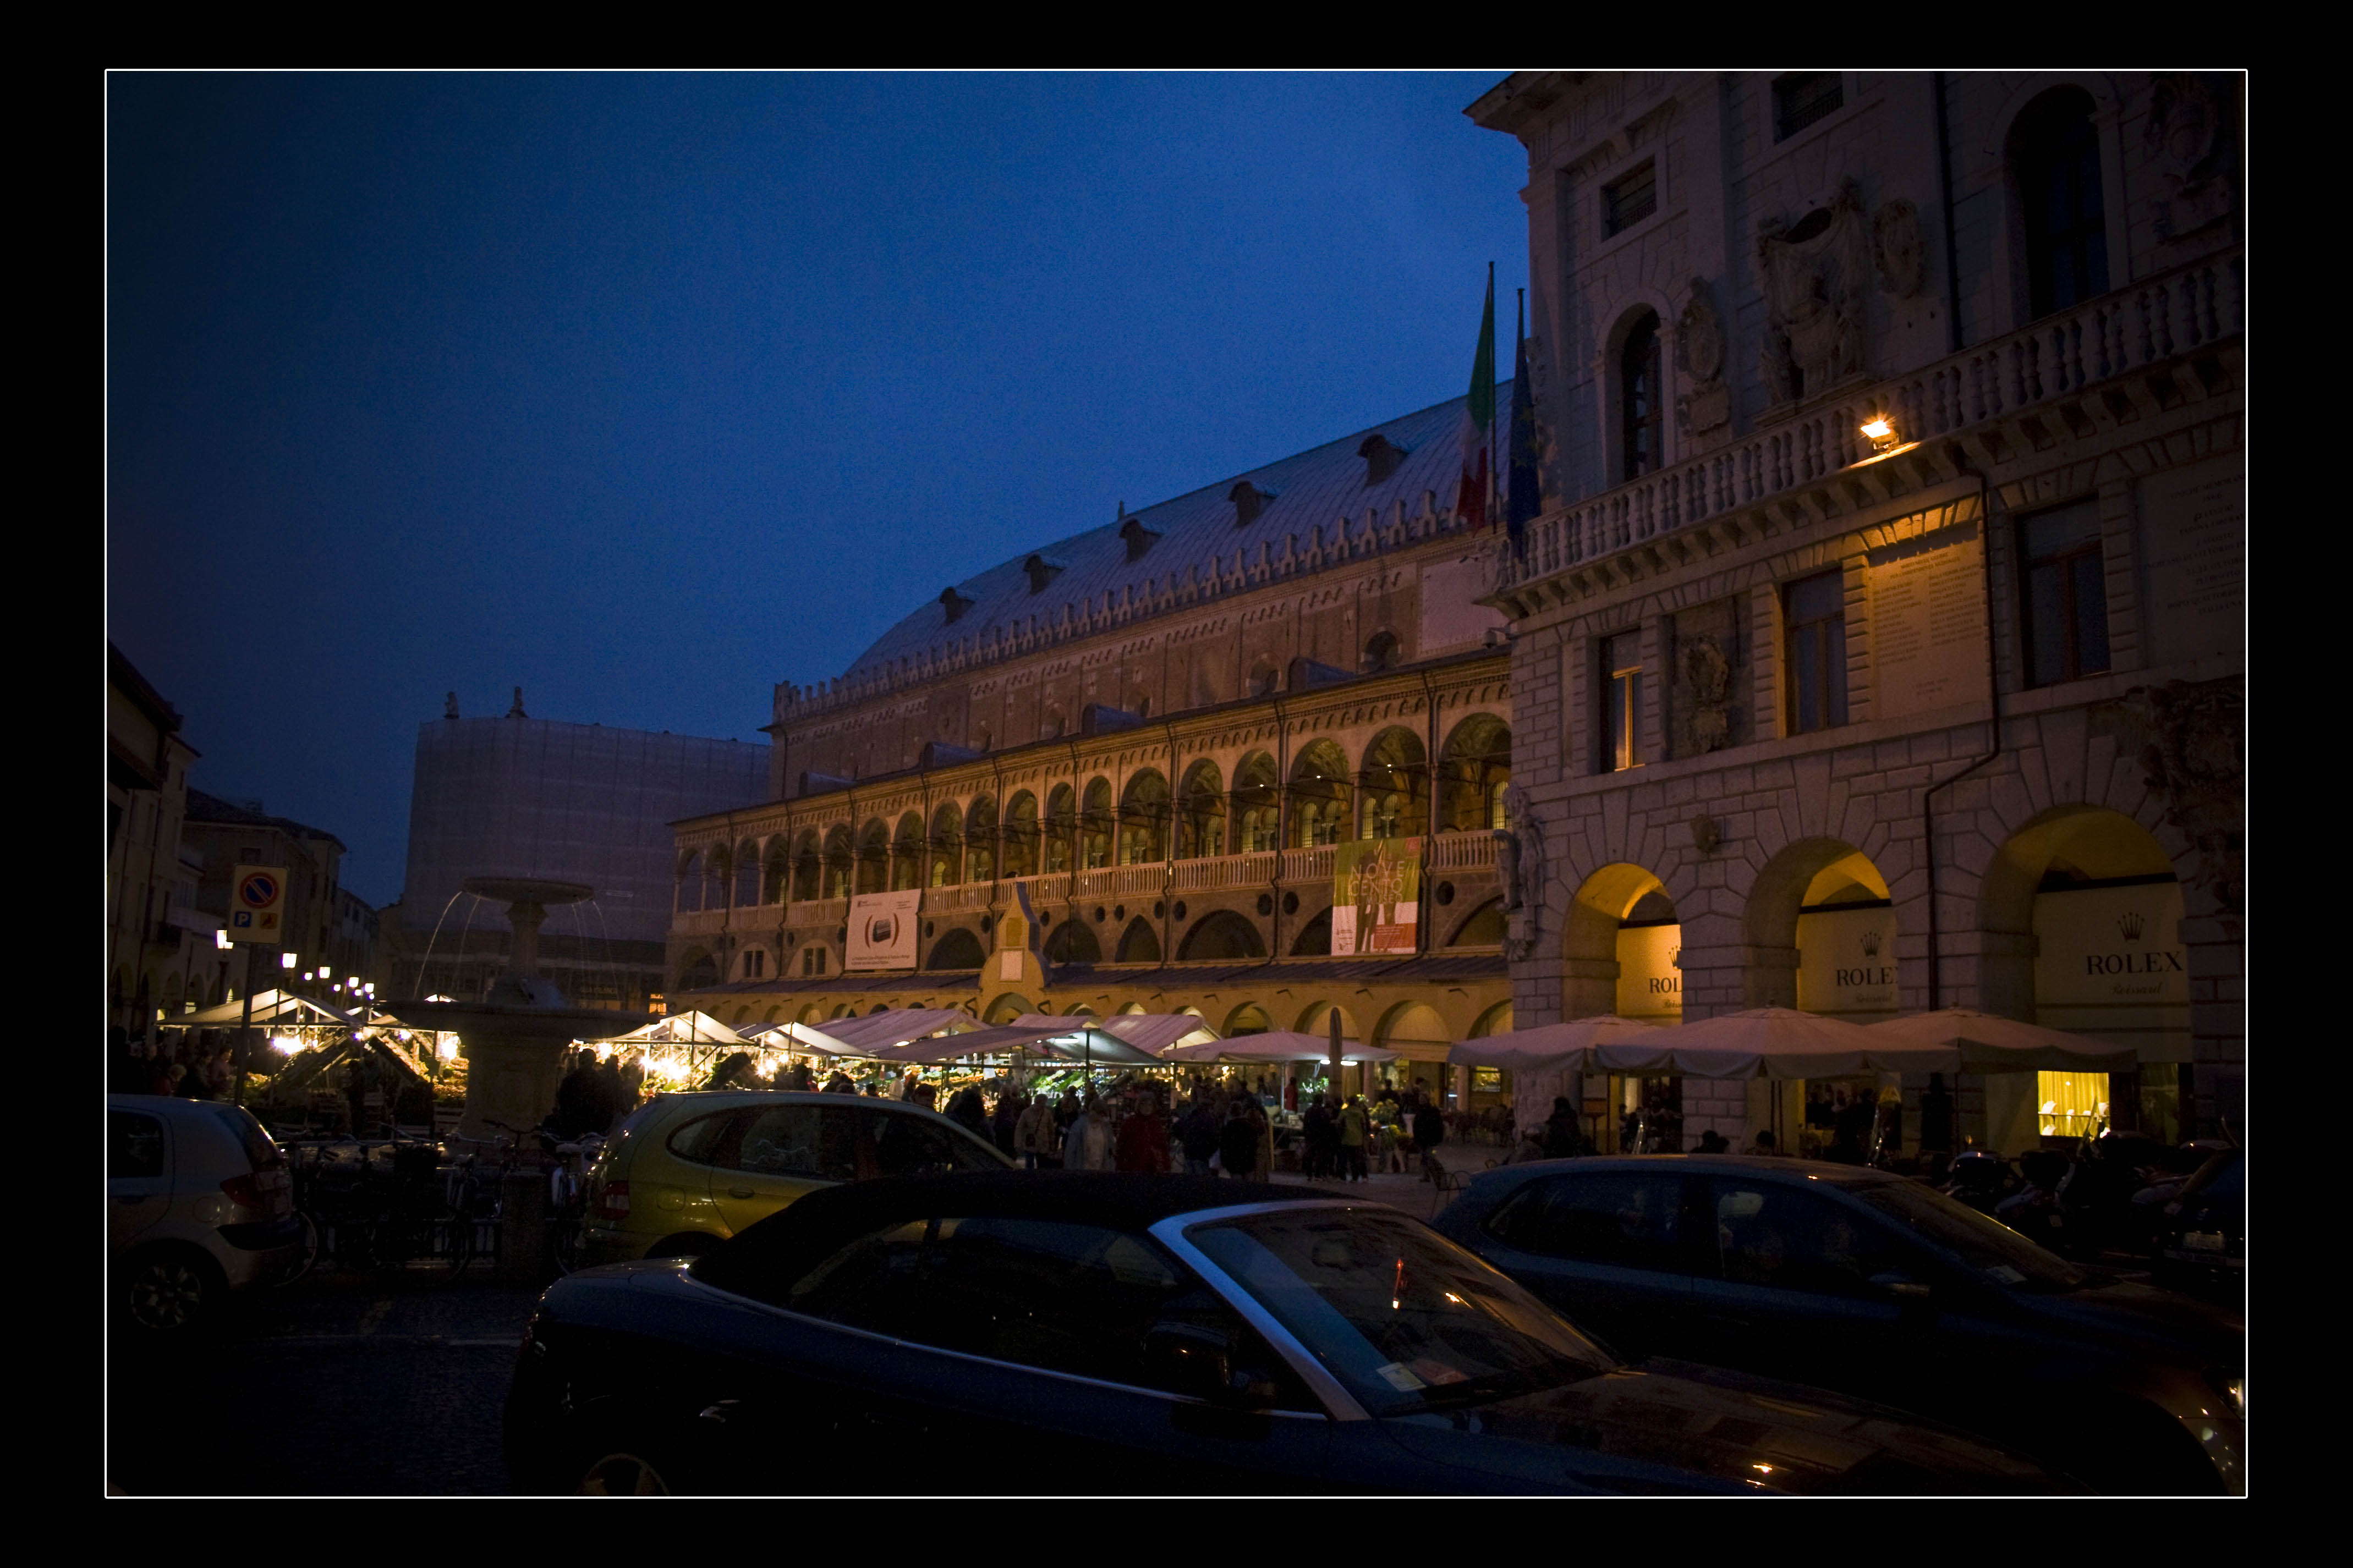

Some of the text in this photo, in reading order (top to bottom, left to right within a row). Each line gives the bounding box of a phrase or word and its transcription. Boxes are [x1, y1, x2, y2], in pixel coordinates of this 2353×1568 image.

[1351, 860, 1405, 881] NOVE
[238, 913, 249, 926] P
[2087, 951, 2183, 975] ROLEX
[1836, 967, 1897, 986] ROLE
